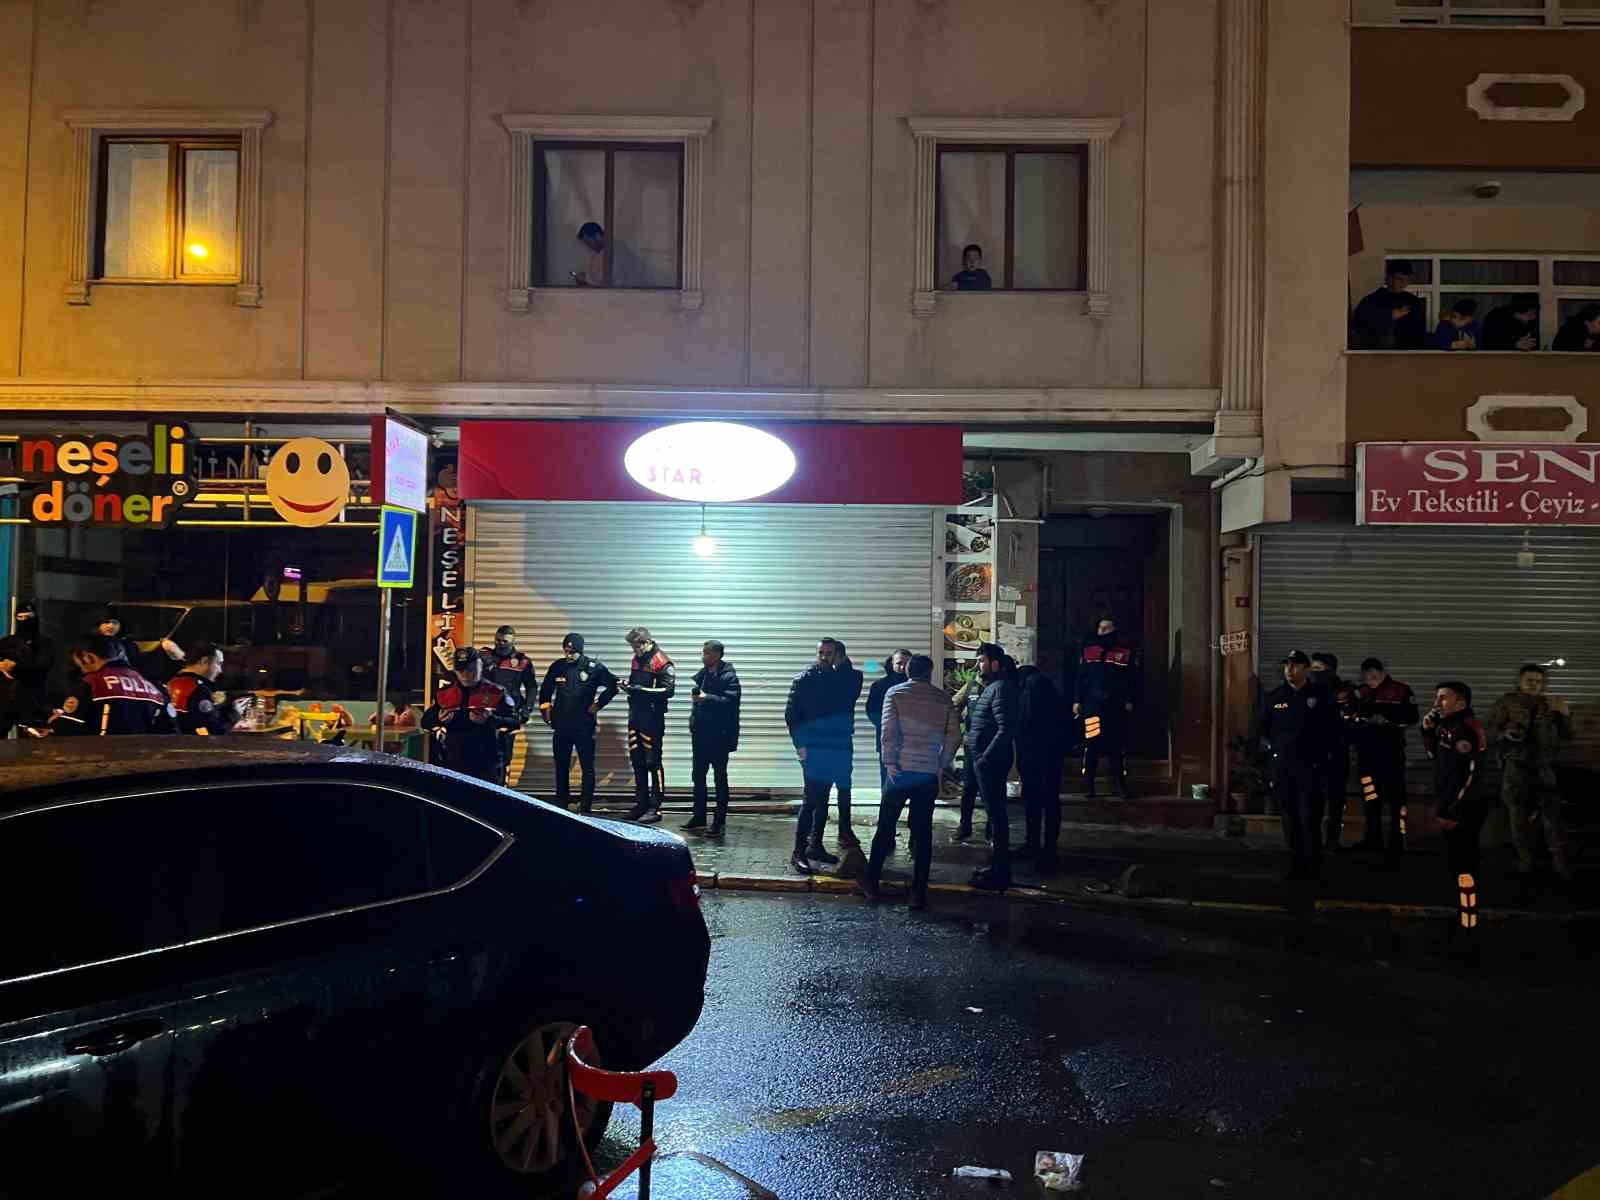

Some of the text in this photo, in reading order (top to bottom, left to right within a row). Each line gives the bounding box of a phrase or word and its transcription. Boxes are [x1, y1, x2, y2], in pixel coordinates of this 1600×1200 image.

[22, 425, 184, 486] neşeli
[648, 466, 702, 485] STAR
[1370, 489, 1401, 513] Ev
[1408, 489, 1499, 513] Tekstili
[1520, 489, 1584, 520] Çeyiz
